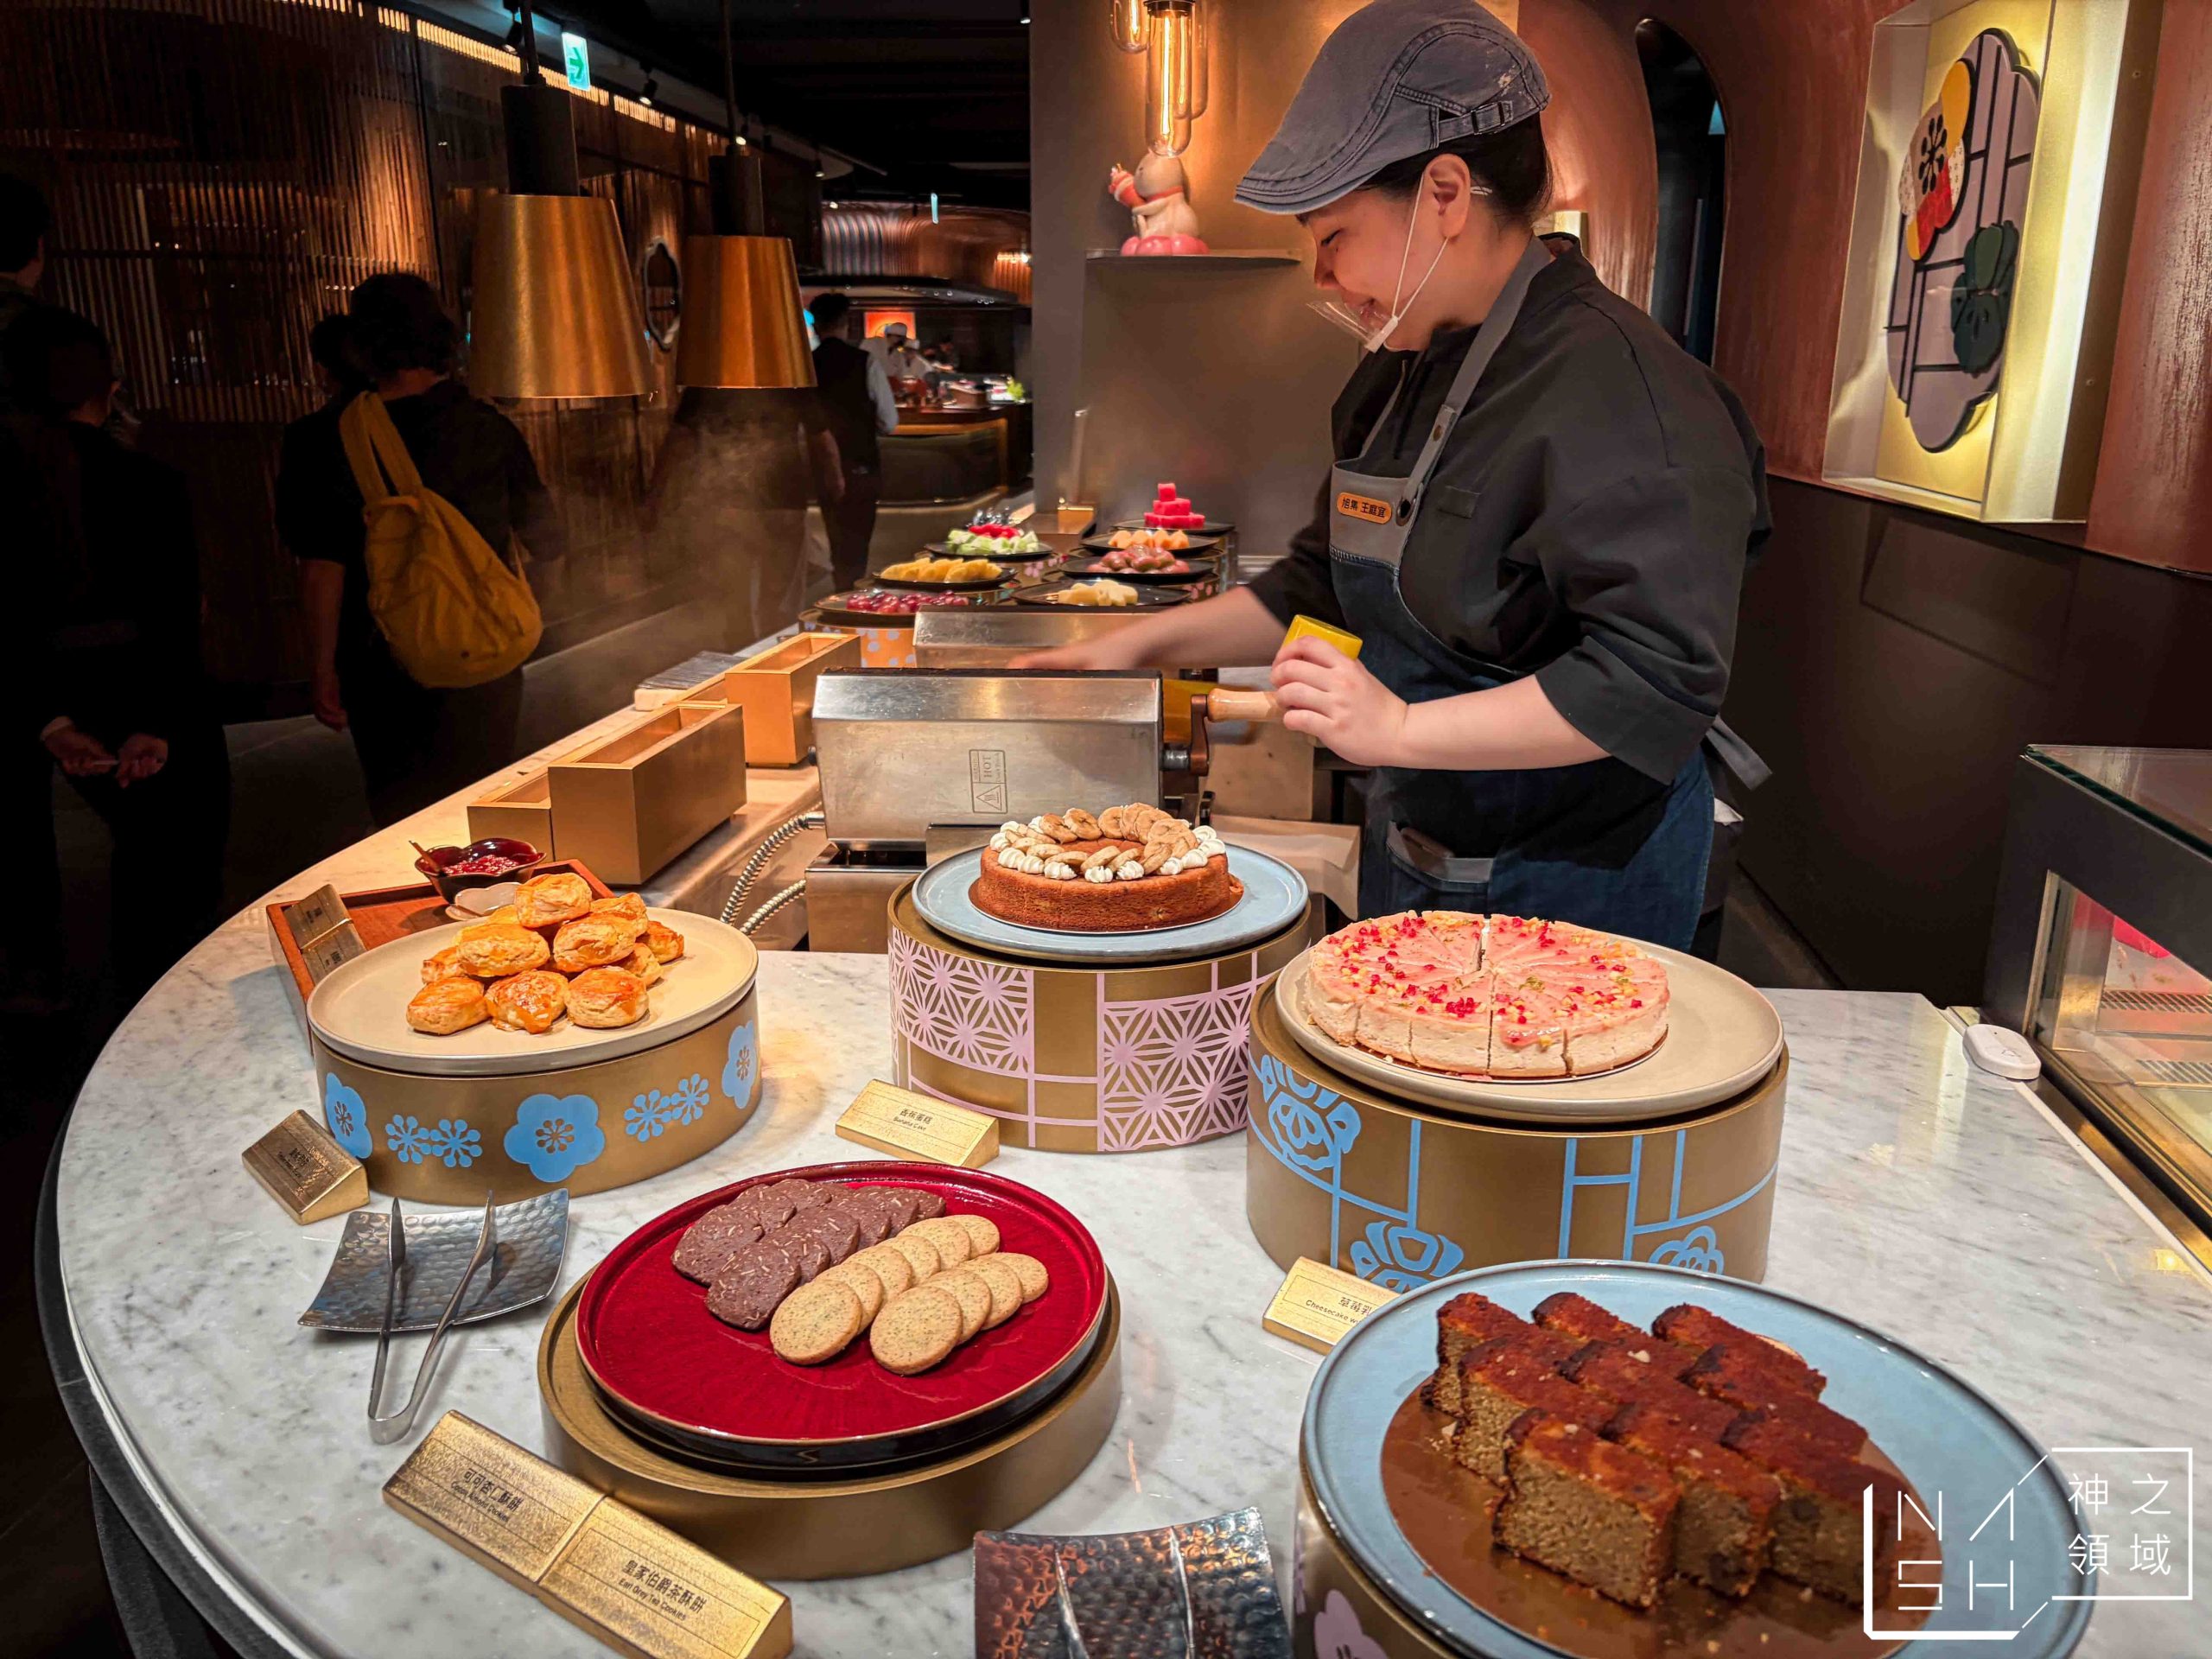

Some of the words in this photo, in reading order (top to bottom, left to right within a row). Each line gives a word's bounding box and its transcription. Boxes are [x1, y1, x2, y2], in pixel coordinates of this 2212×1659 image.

[1360, 501, 1386, 518] 王庭宜
[1306, 1300, 1349, 1320] Cheesecake
[464, 1468, 524, 1512] 可可杏仁酥餅
[619, 1578, 633, 1590] Earl
[632, 1586, 649, 1600] Grey
[649, 1593, 661, 1606] Tea
[660, 1601, 687, 1621] Cookies
[622, 1560, 708, 1614] 皇家伯爵茶酥餅
